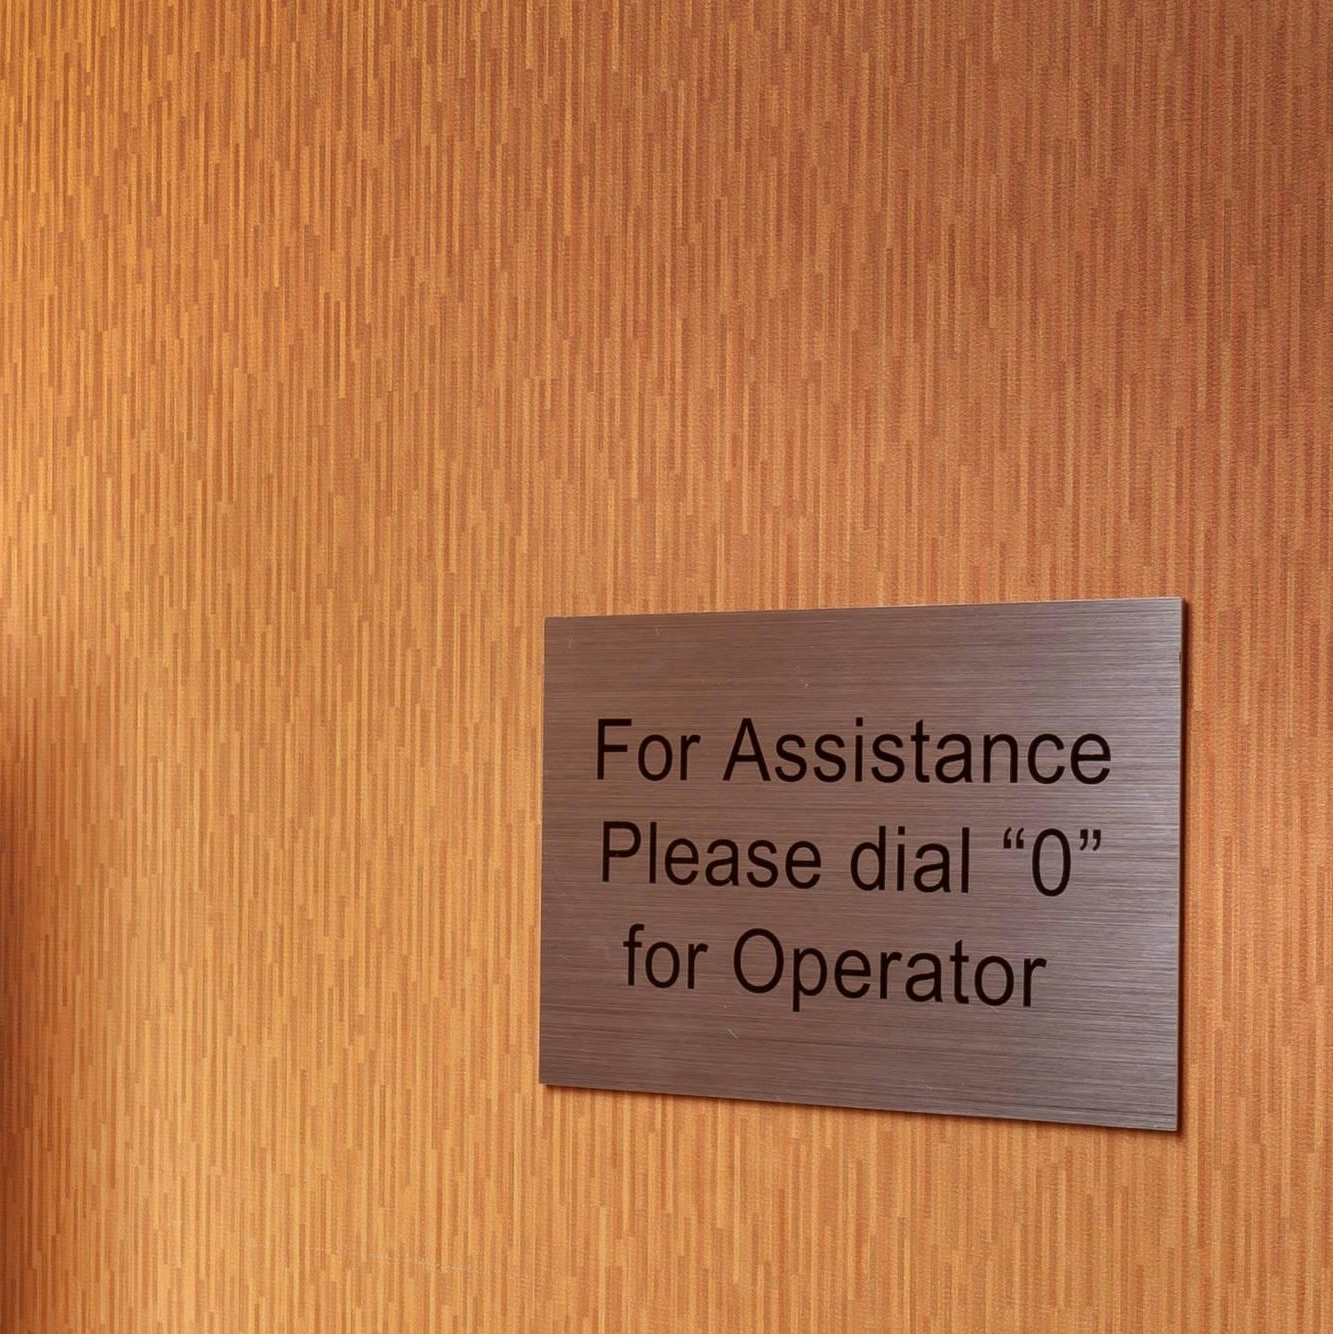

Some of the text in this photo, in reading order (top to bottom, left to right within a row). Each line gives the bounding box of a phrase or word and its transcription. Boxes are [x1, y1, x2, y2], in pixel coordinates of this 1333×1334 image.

[596, 716, 1112, 785] For Assistance
[601, 820, 823, 889] Please
[849, 825, 970, 894] dial
[622, 924, 1046, 1012] for Operator
